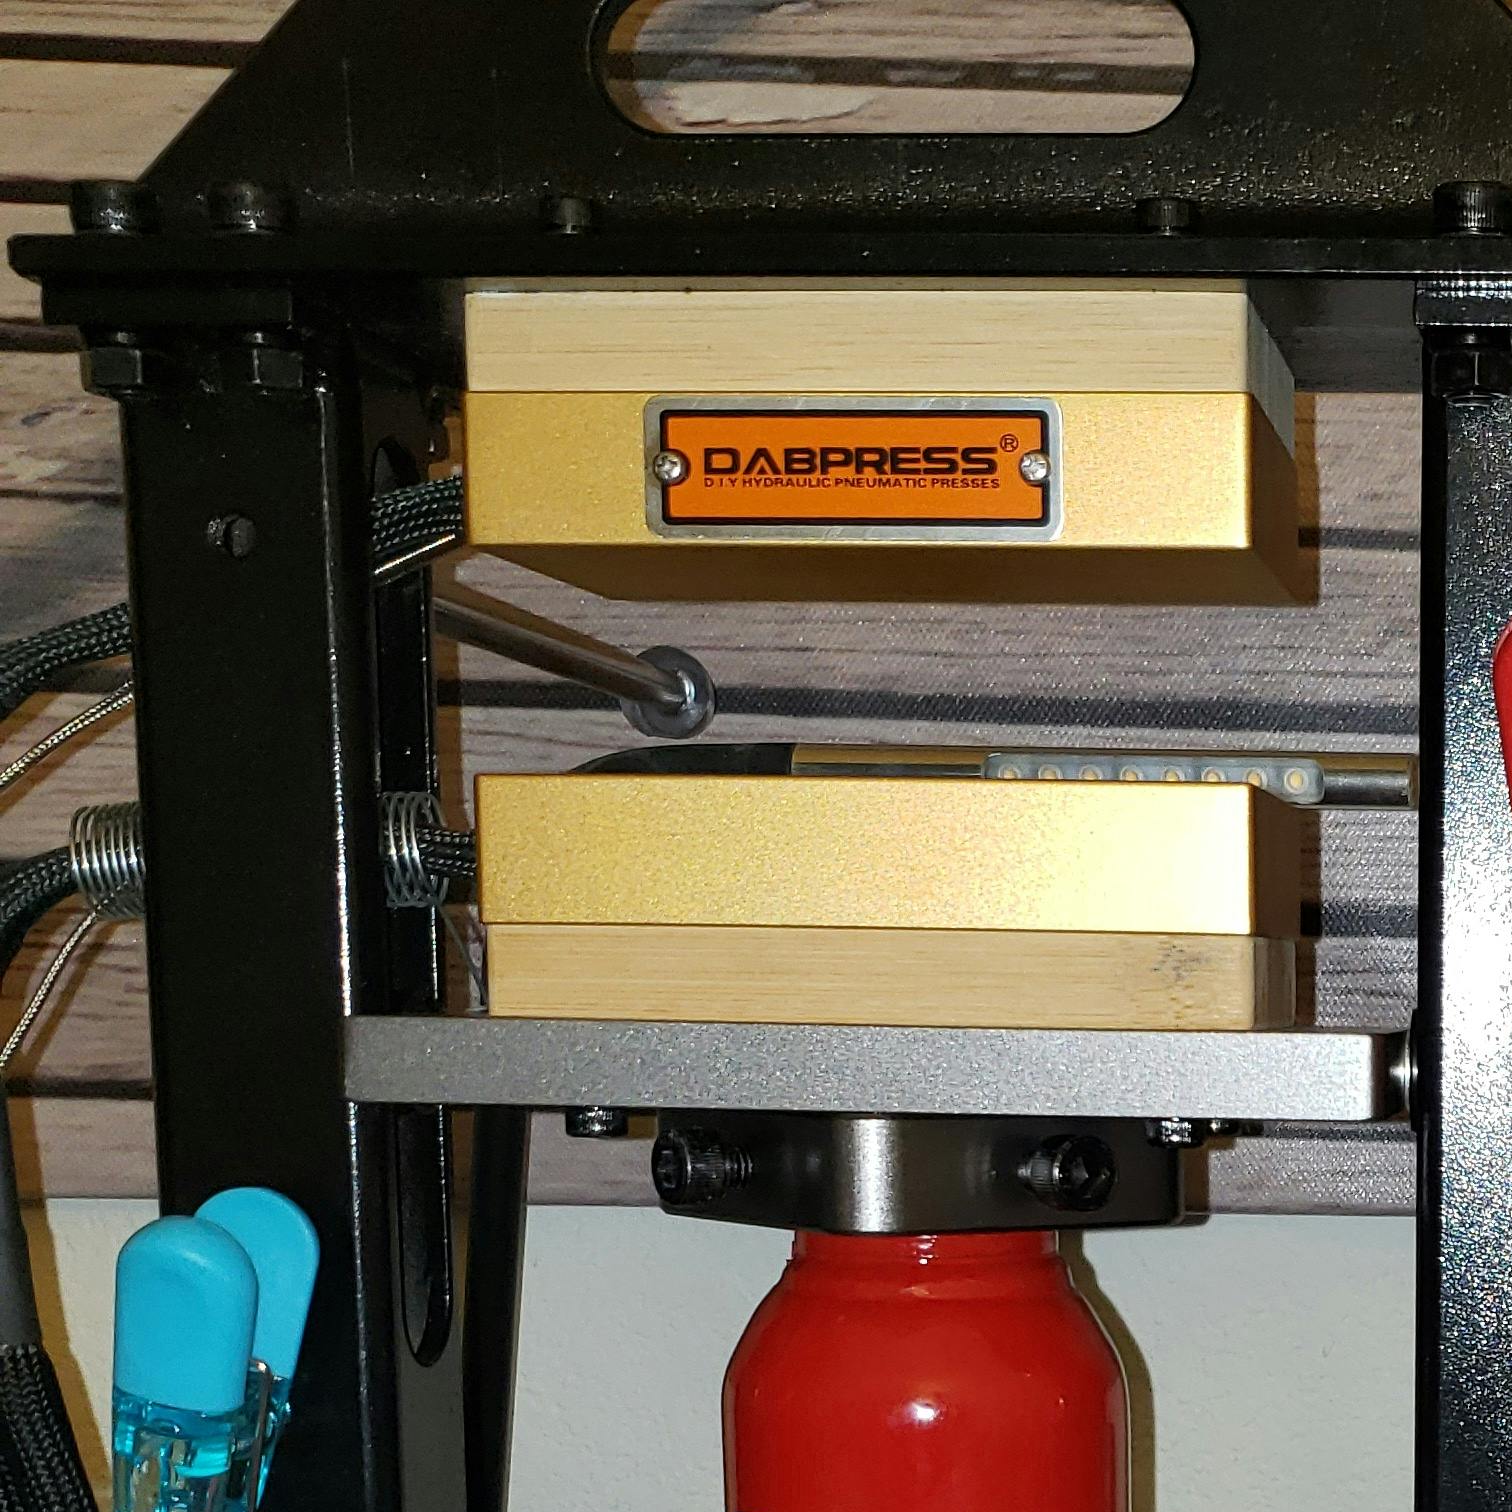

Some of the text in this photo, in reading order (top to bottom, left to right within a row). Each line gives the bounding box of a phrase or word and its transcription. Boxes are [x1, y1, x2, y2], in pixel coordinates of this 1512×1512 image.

[743, 477, 831, 488] HYDRAULIC
[835, 477, 927, 489] PNEUMATIC
[931, 478, 1000, 489] PRESSES
